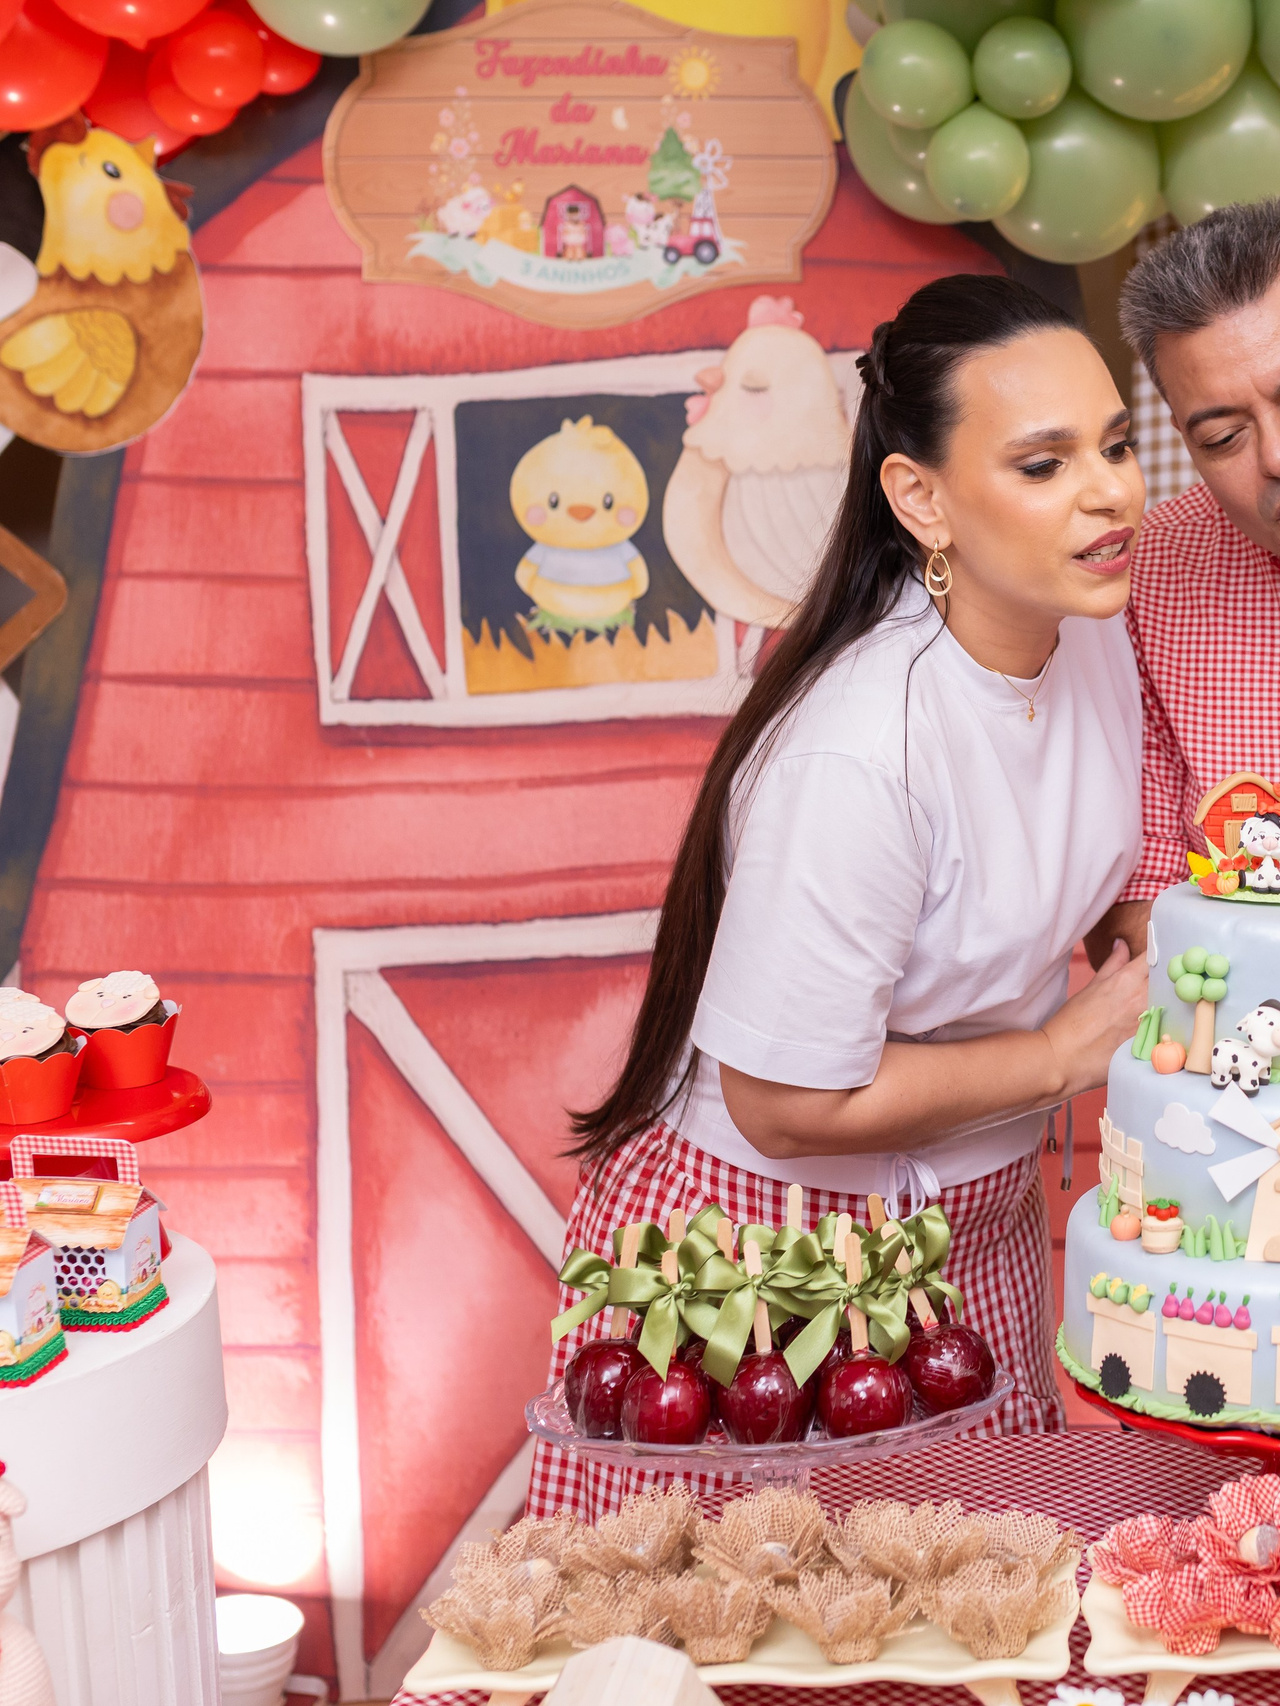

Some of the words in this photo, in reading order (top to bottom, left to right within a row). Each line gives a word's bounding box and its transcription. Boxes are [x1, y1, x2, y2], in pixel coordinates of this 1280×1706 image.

[475, 39, 669, 88] Fazendinha
[550, 91, 597, 124] da
[494, 127, 650, 168] Mariana
[536, 261, 631, 284] ANINHOS
